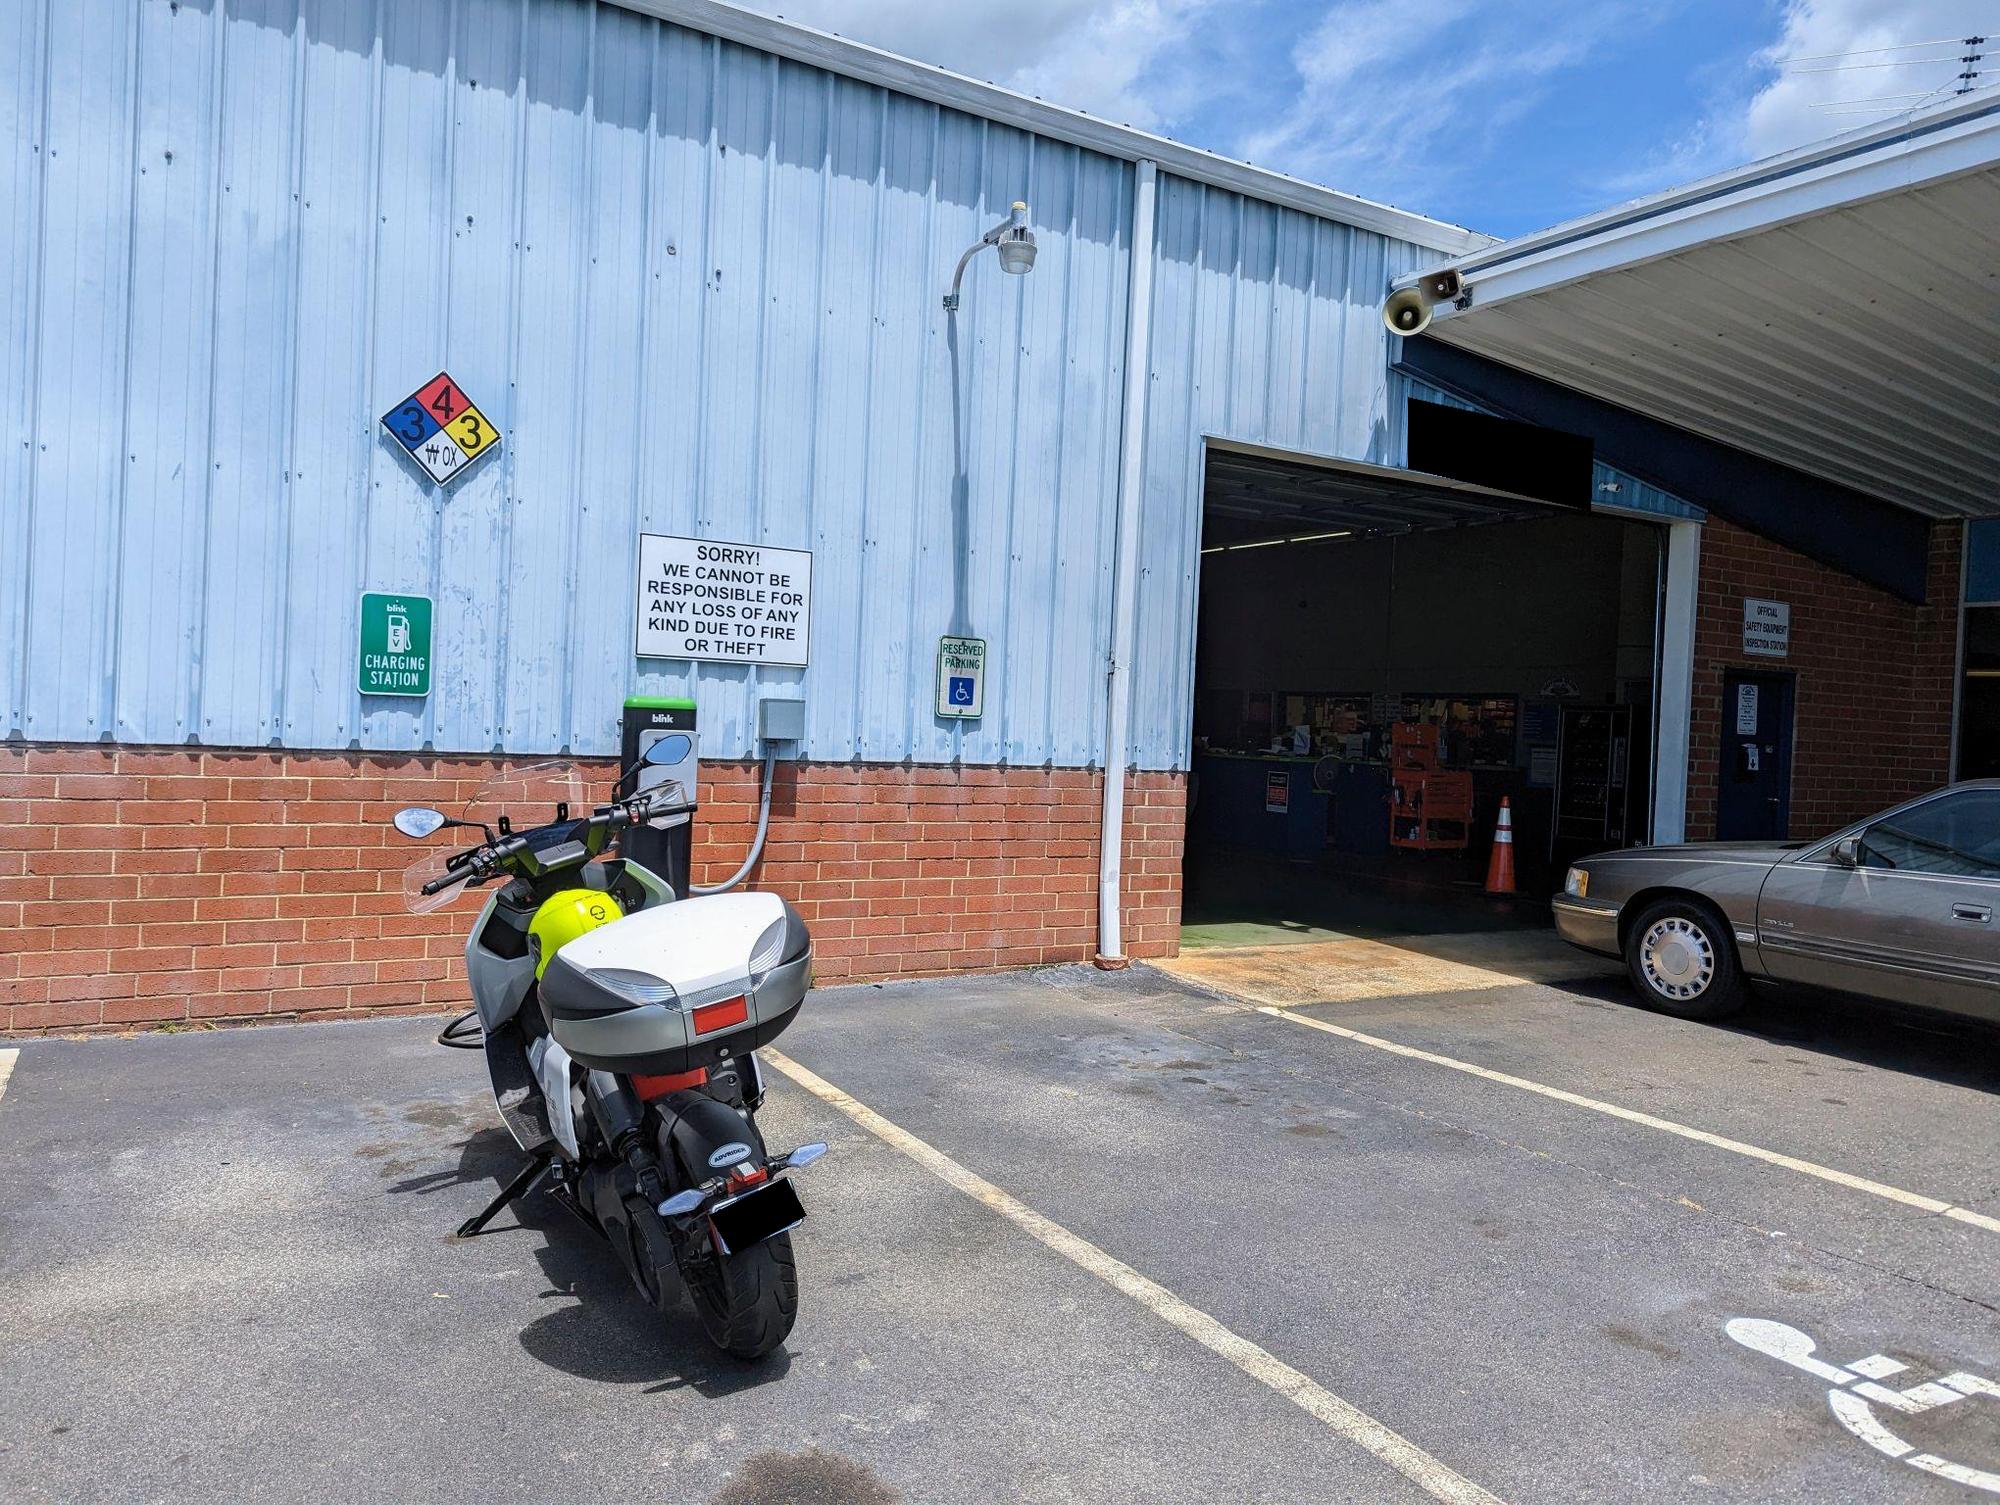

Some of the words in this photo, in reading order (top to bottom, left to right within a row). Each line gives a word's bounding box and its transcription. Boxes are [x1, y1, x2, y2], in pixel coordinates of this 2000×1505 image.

[432, 384, 454, 420] 4
[401, 406, 426, 442] 3
[459, 415, 482, 450] 3
[442, 446, 457, 467] OX
[697, 545, 760, 566] SORRY!
[663, 563, 690, 578] WE
[695, 566, 764, 584] CANNOT
[770, 574, 791, 588] BE
[648, 580, 766, 603] RESPONSIBLE
[771, 591, 803, 606] FOR
[386, 604, 407, 613] blink
[651, 599, 687, 614] ANY
[692, 602, 736, 618] LOSS
[741, 607, 763, 620] OF
[766, 609, 799, 623] ANY
[1757, 606, 1778, 618] OFFICIAL
[648, 617, 689, 632] KIND
[695, 621, 729, 635] DUE
[735, 624, 756, 638] TO
[761, 626, 796, 641] FIRE
[1746, 620, 1763, 632] SAFETY
[684, 638, 709, 653] OR
[714, 640, 766, 656] THEFT
[943, 643, 983, 656] RESERVED
[365, 654, 425, 670] CHARGING
[945, 657, 980, 670] PARKING
[370, 671, 419, 687] STATION
[652, 713, 674, 724] blink
